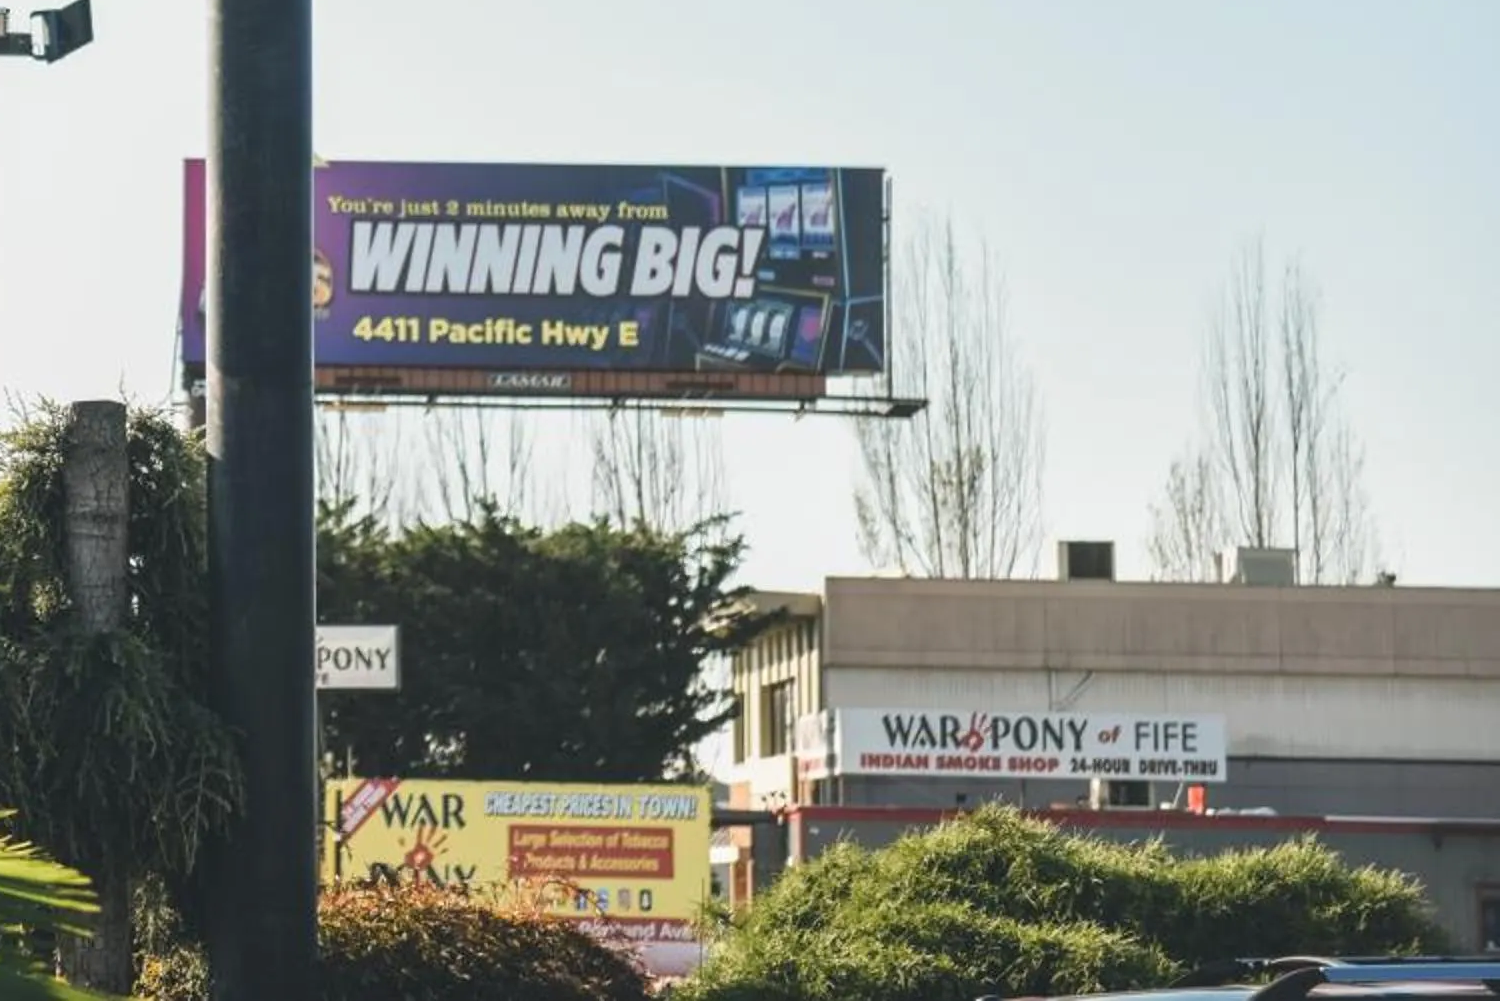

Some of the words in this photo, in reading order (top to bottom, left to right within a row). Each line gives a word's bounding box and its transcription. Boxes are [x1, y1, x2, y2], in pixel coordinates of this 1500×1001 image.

[328, 196, 394, 215] You're
[398, 198, 440, 218] just
[446, 200, 459, 215] 2
[466, 199, 550, 217] minutes
[556, 202, 611, 222] away
[617, 200, 669, 219] from
[350, 220, 625, 296] WINNING
[630, 225, 765, 299] BIG!
[353, 316, 420, 343] 4411
[429, 317, 533, 345] Pacific
[541, 320, 610, 351] Hwy
[618, 321, 639, 346] E
[317, 646, 391, 671] PONY
[882, 713, 963, 749] WAR
[991, 715, 1088, 752] PONY
[1098, 725, 1122, 744] of
[1134, 721, 1197, 752] FIFE
[860, 753, 929, 769] INDIAN
[936, 755, 1001, 771] SMOKE
[1008, 756, 1060, 773] SHOP
[1070, 757, 1131, 774] 24-HOUR
[1139, 758, 1218, 776] DRIVE-THRU
[381, 792, 466, 829] WAR
[484, 790, 556, 817] CHEAPEST
[556, 792, 614, 818] PRICES
